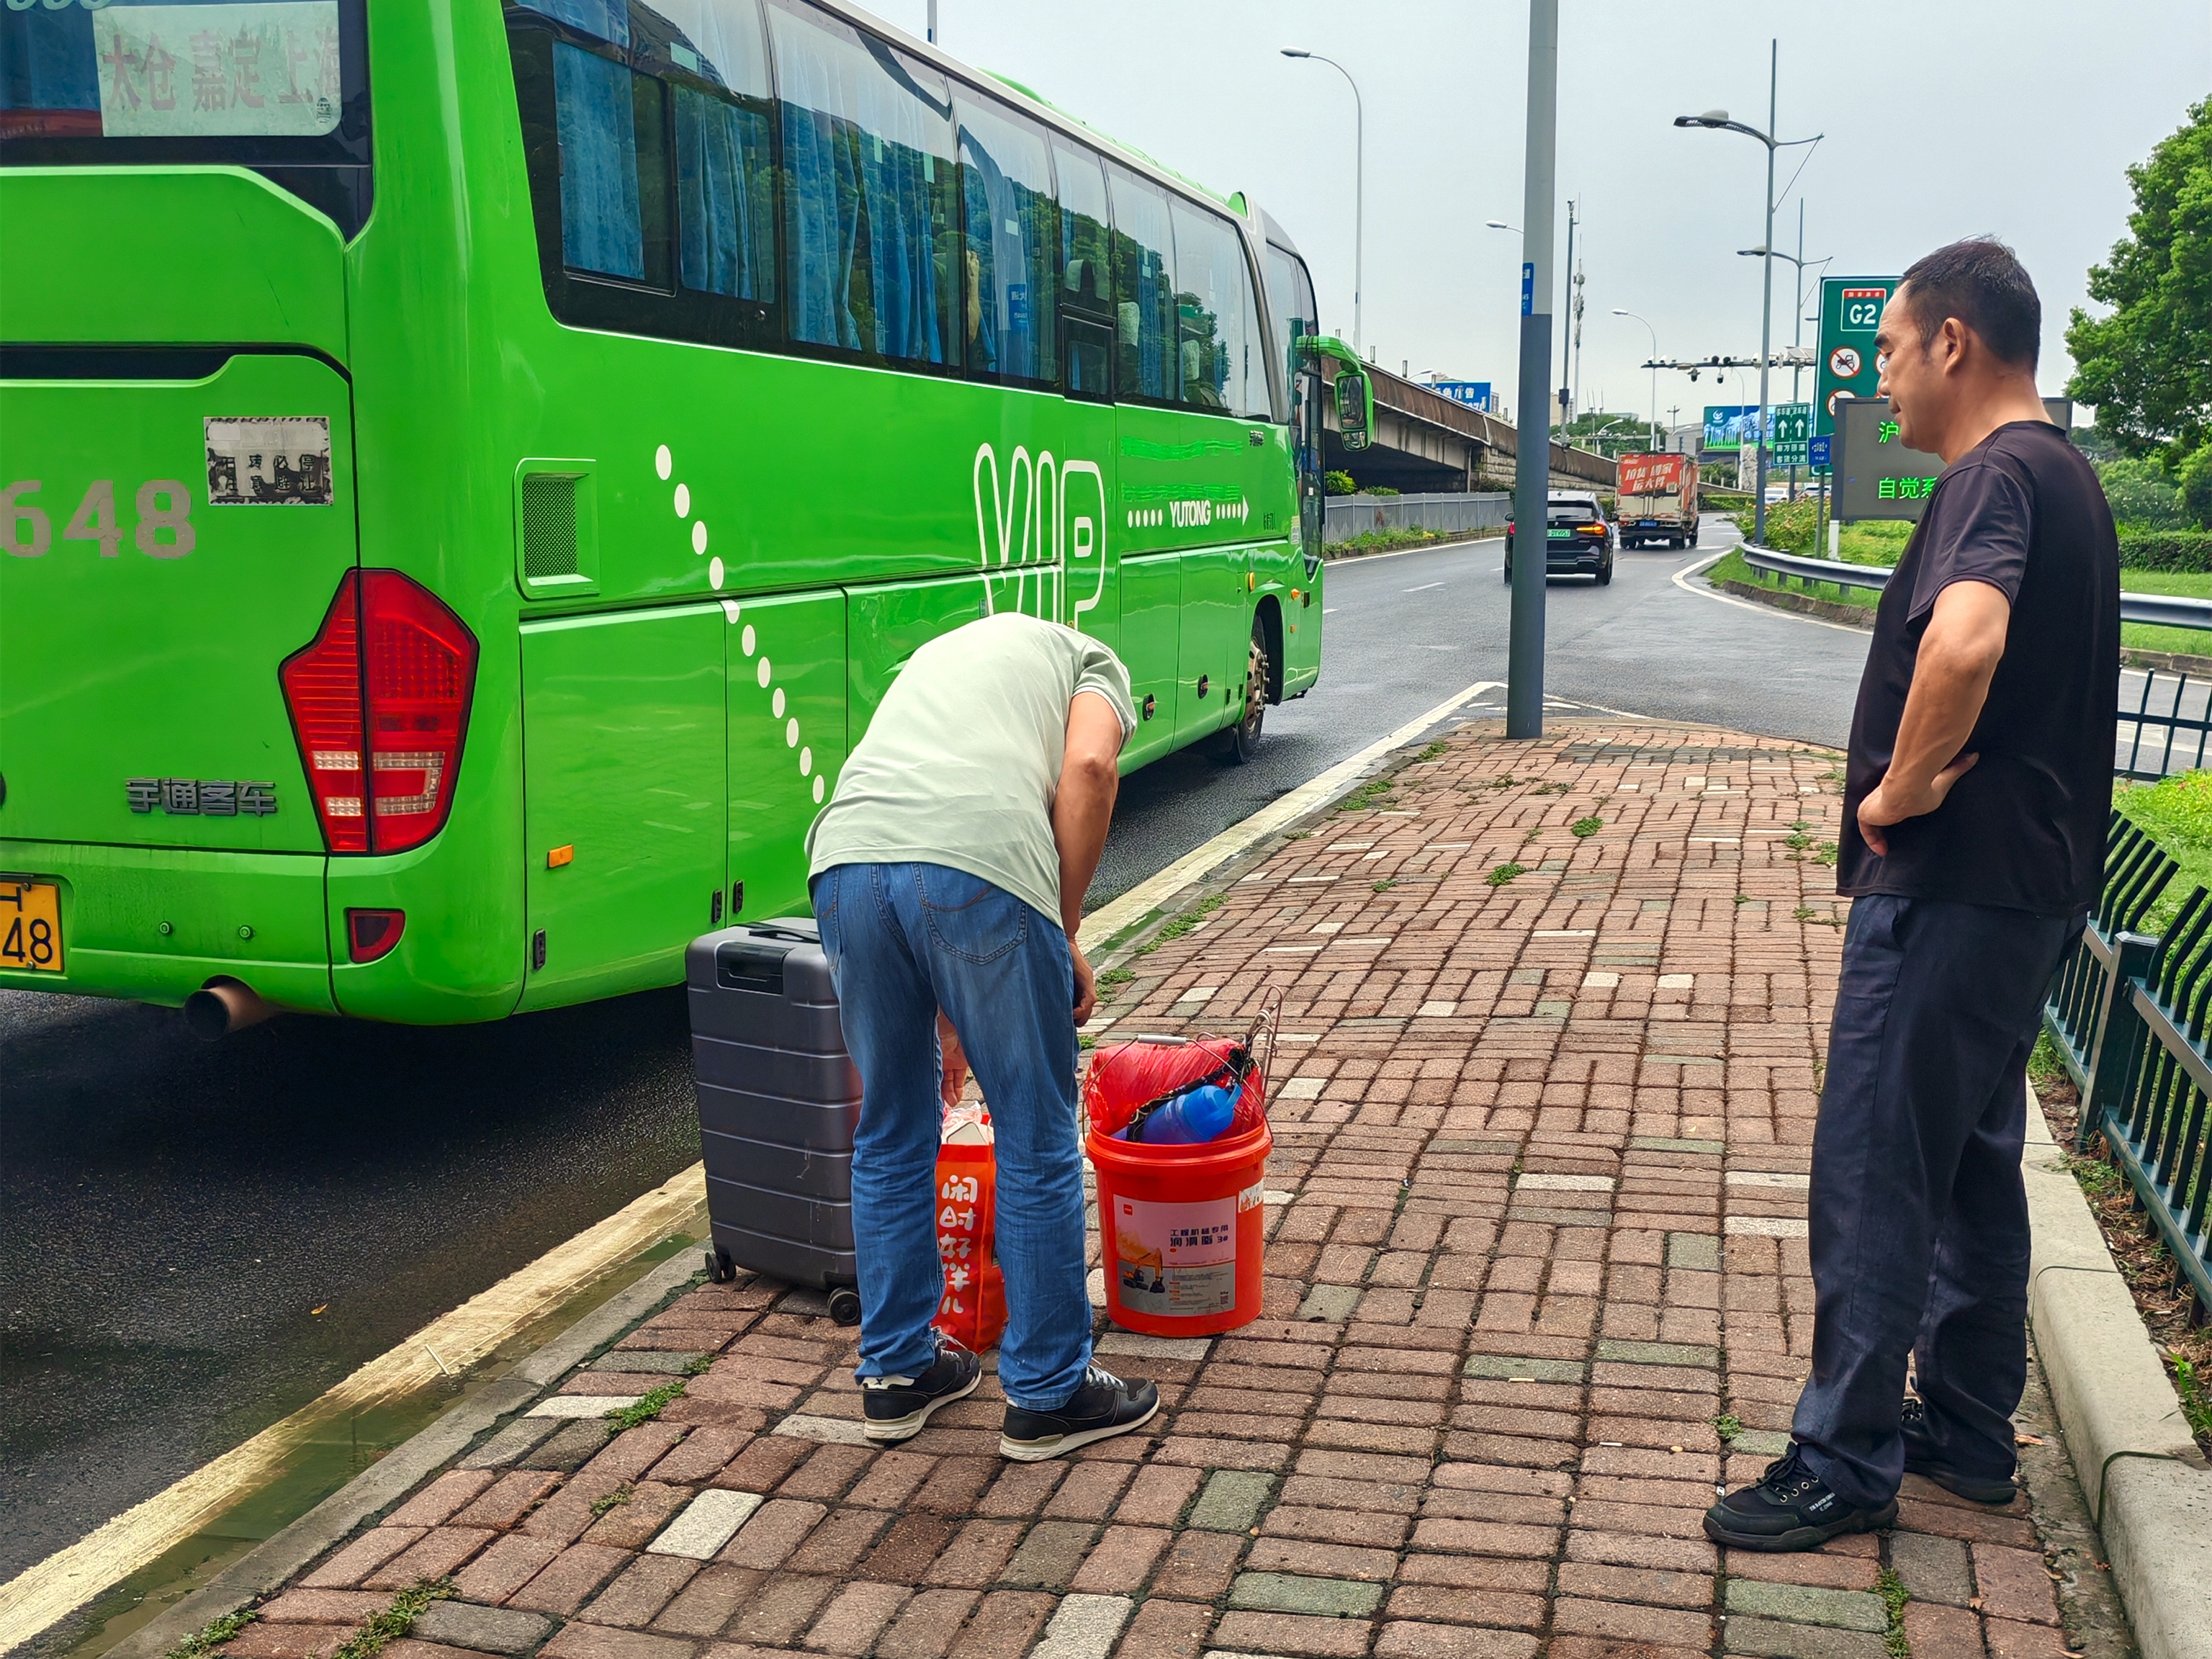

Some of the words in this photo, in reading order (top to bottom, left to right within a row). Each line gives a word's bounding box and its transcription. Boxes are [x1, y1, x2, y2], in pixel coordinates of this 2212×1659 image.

[1849, 304, 1876, 324] G2
[0, 480, 196, 559] 648
[1169, 500, 1211, 528] YUTONG
[125, 777, 278, 817] 宇通客车
[2, 917, 53, 964] 48
